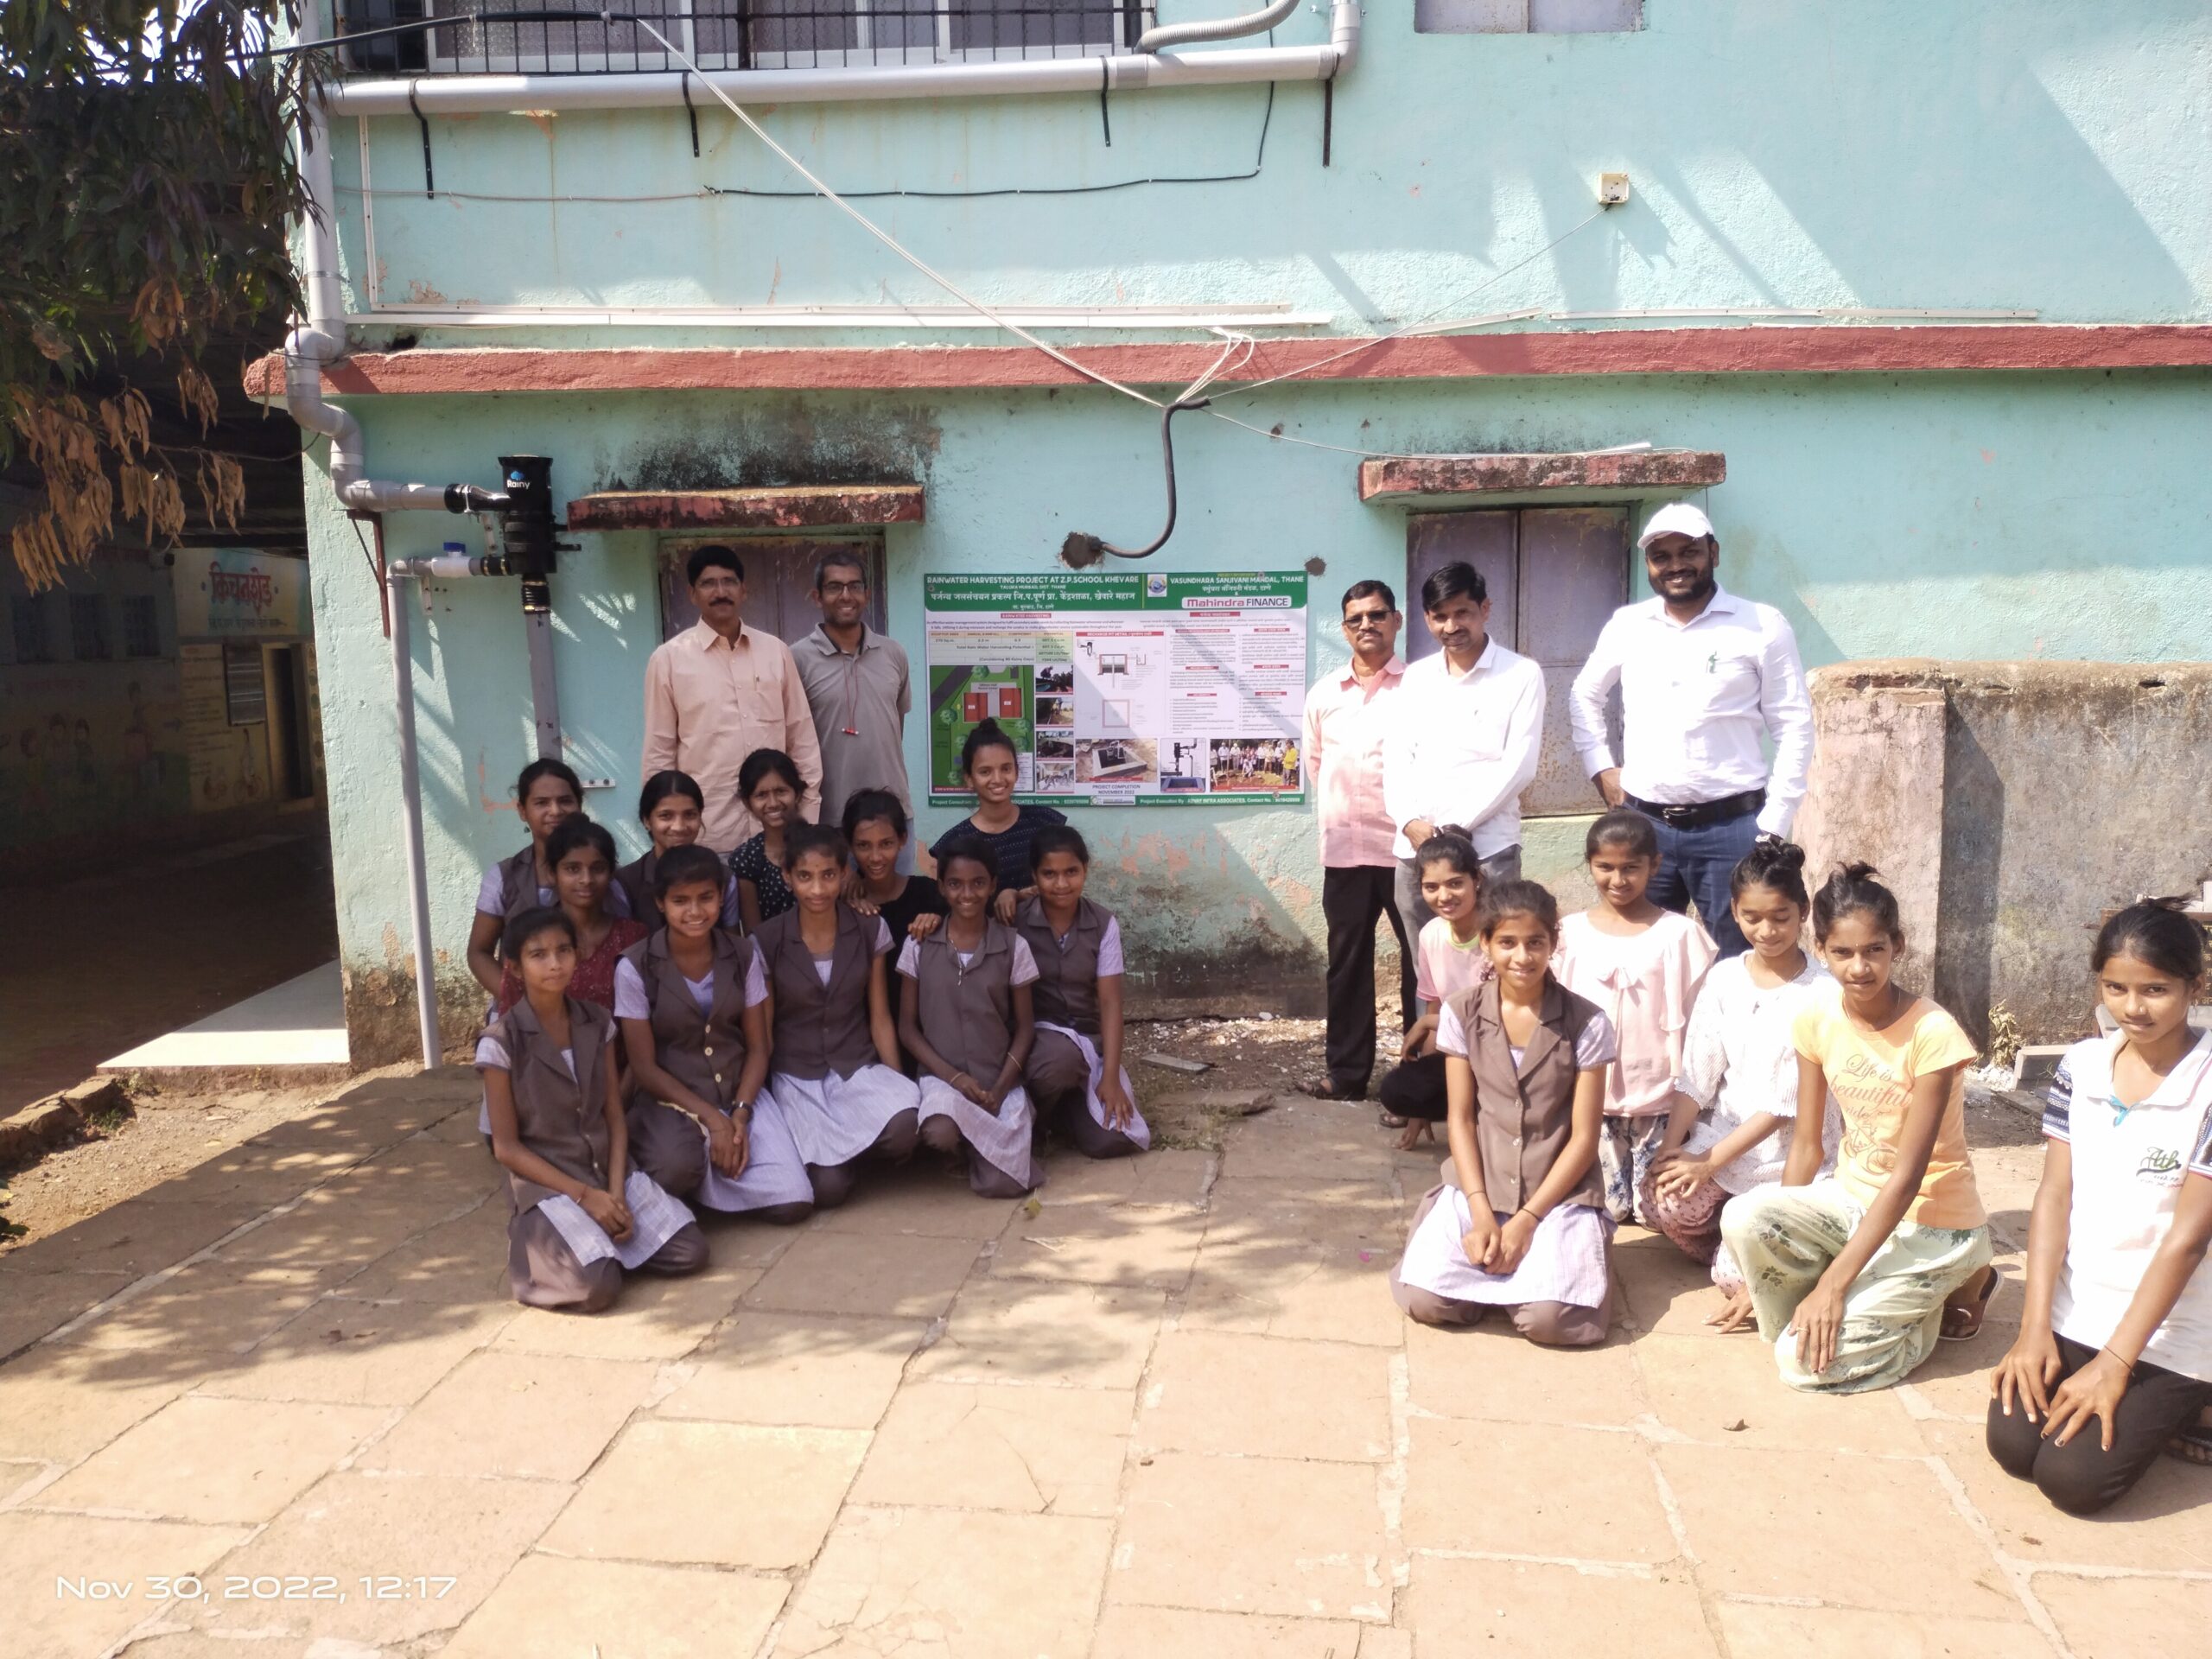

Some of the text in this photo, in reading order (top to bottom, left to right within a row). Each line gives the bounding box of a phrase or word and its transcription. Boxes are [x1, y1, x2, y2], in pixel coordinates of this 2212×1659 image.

[506, 480, 531, 490] Rainy
[1187, 598, 1288, 607] Mahindra FINANCE
[1841, 1053, 1895, 1083] Life is
[1830, 1074, 1913, 1110] beautiful
